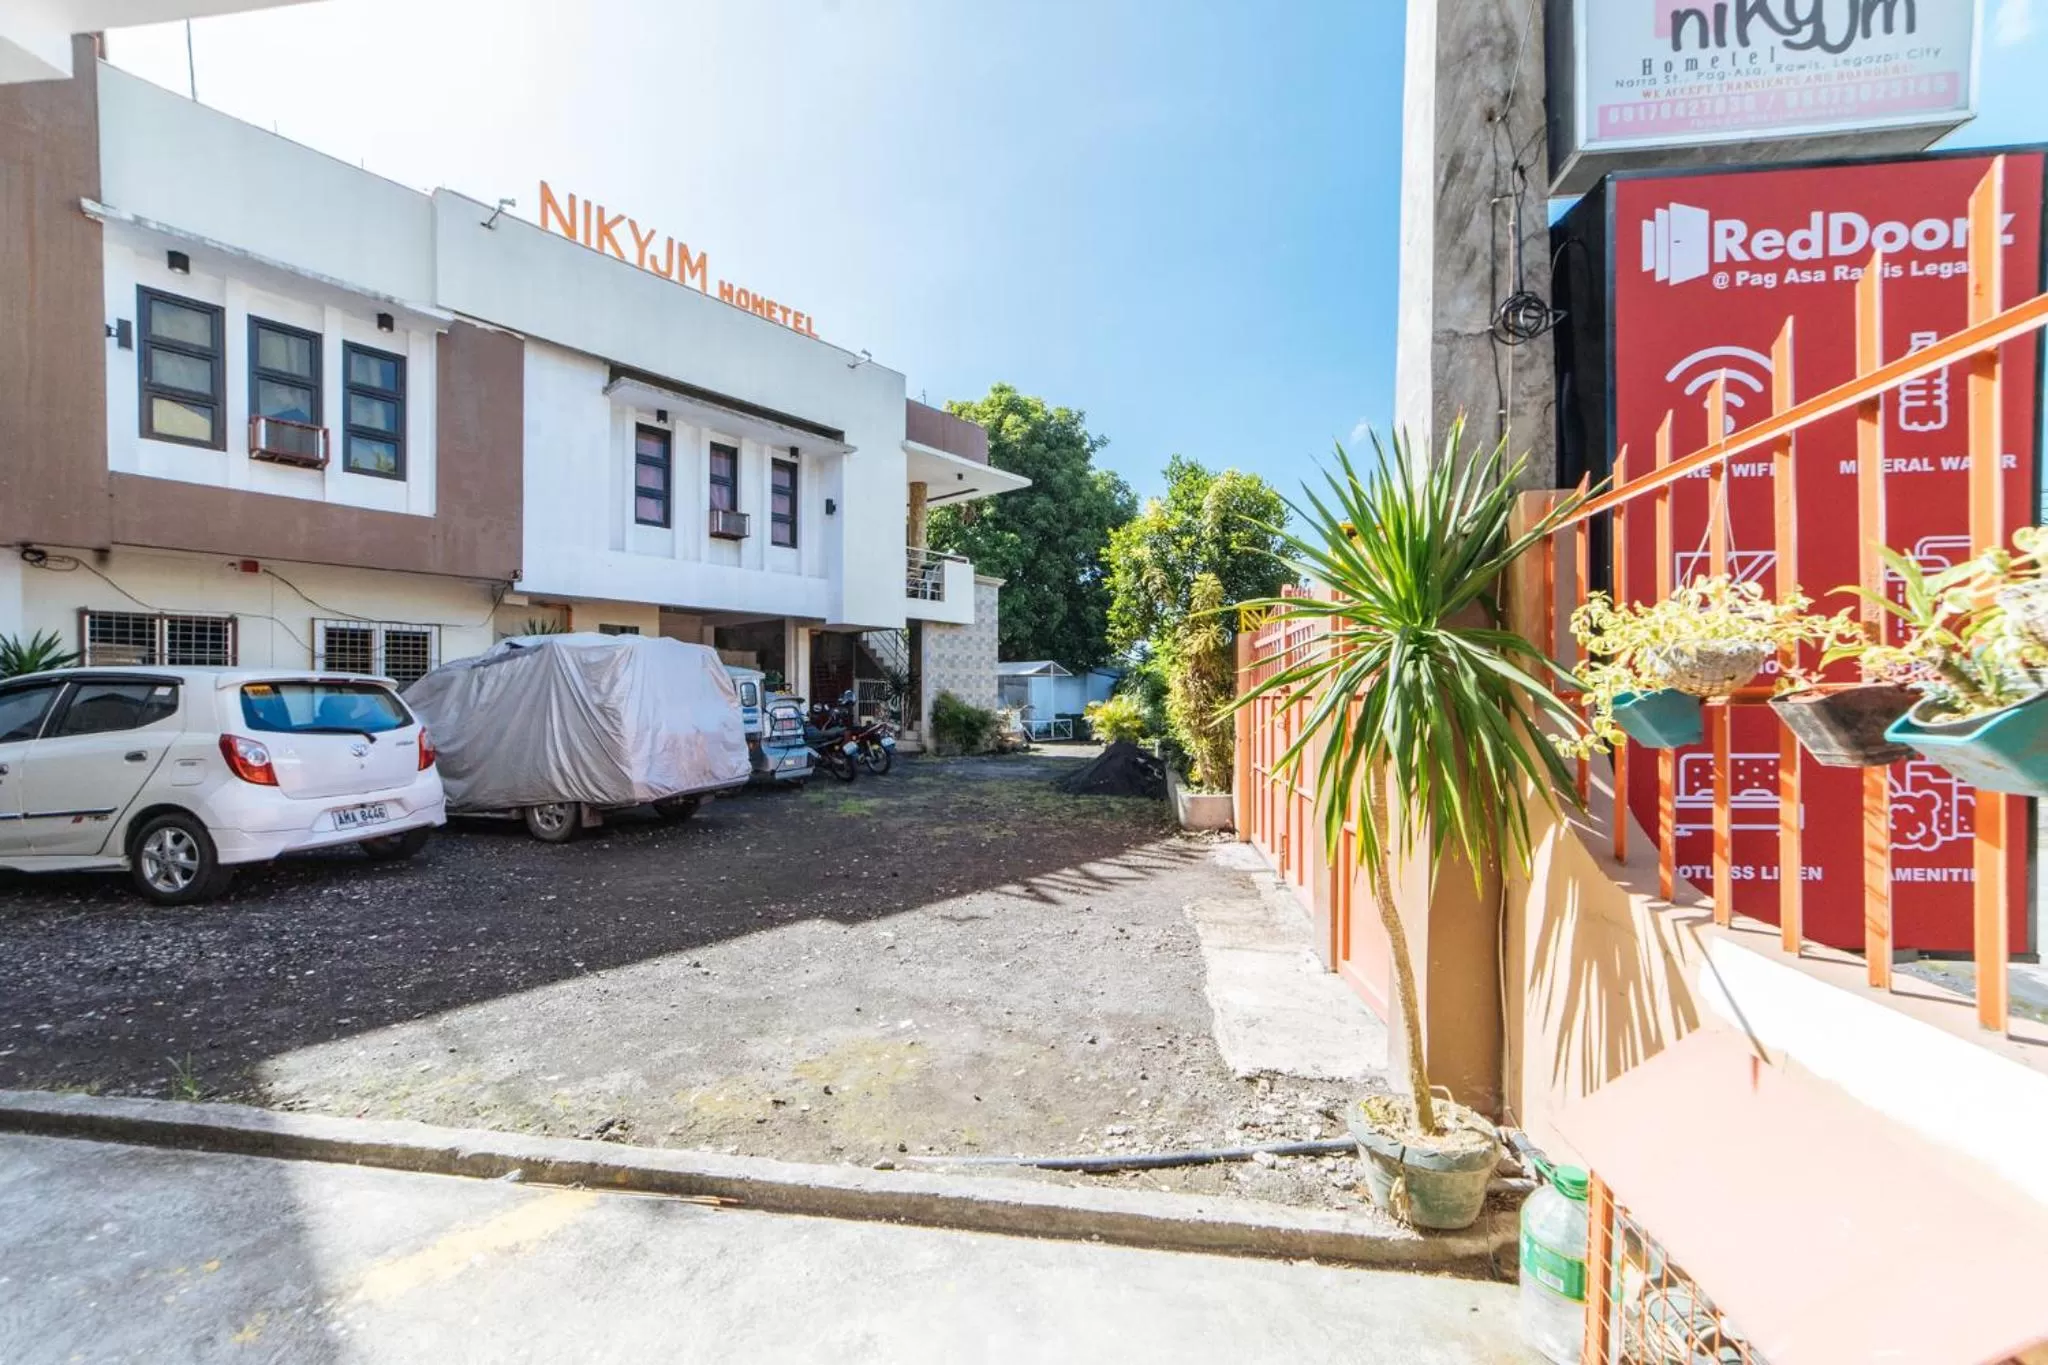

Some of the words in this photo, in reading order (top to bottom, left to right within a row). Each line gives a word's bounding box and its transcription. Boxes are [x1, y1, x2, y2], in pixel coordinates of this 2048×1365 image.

[1641, 46, 1775, 76] Hometel
[1907, 48, 1942, 60] City
[540, 180, 707, 295] NIKYJM
[719, 279, 820, 340] HOMETEL
[1713, 272, 1730, 289] @
[1735, 269, 1778, 289] Pag
[1784, 267, 1827, 284] Asa
[1834, 262, 1904, 281] Rais
[1839, 457, 1935, 475] MERAL
[338, 810, 359, 825] AMA
[1760, 866, 1823, 881] LIEN
